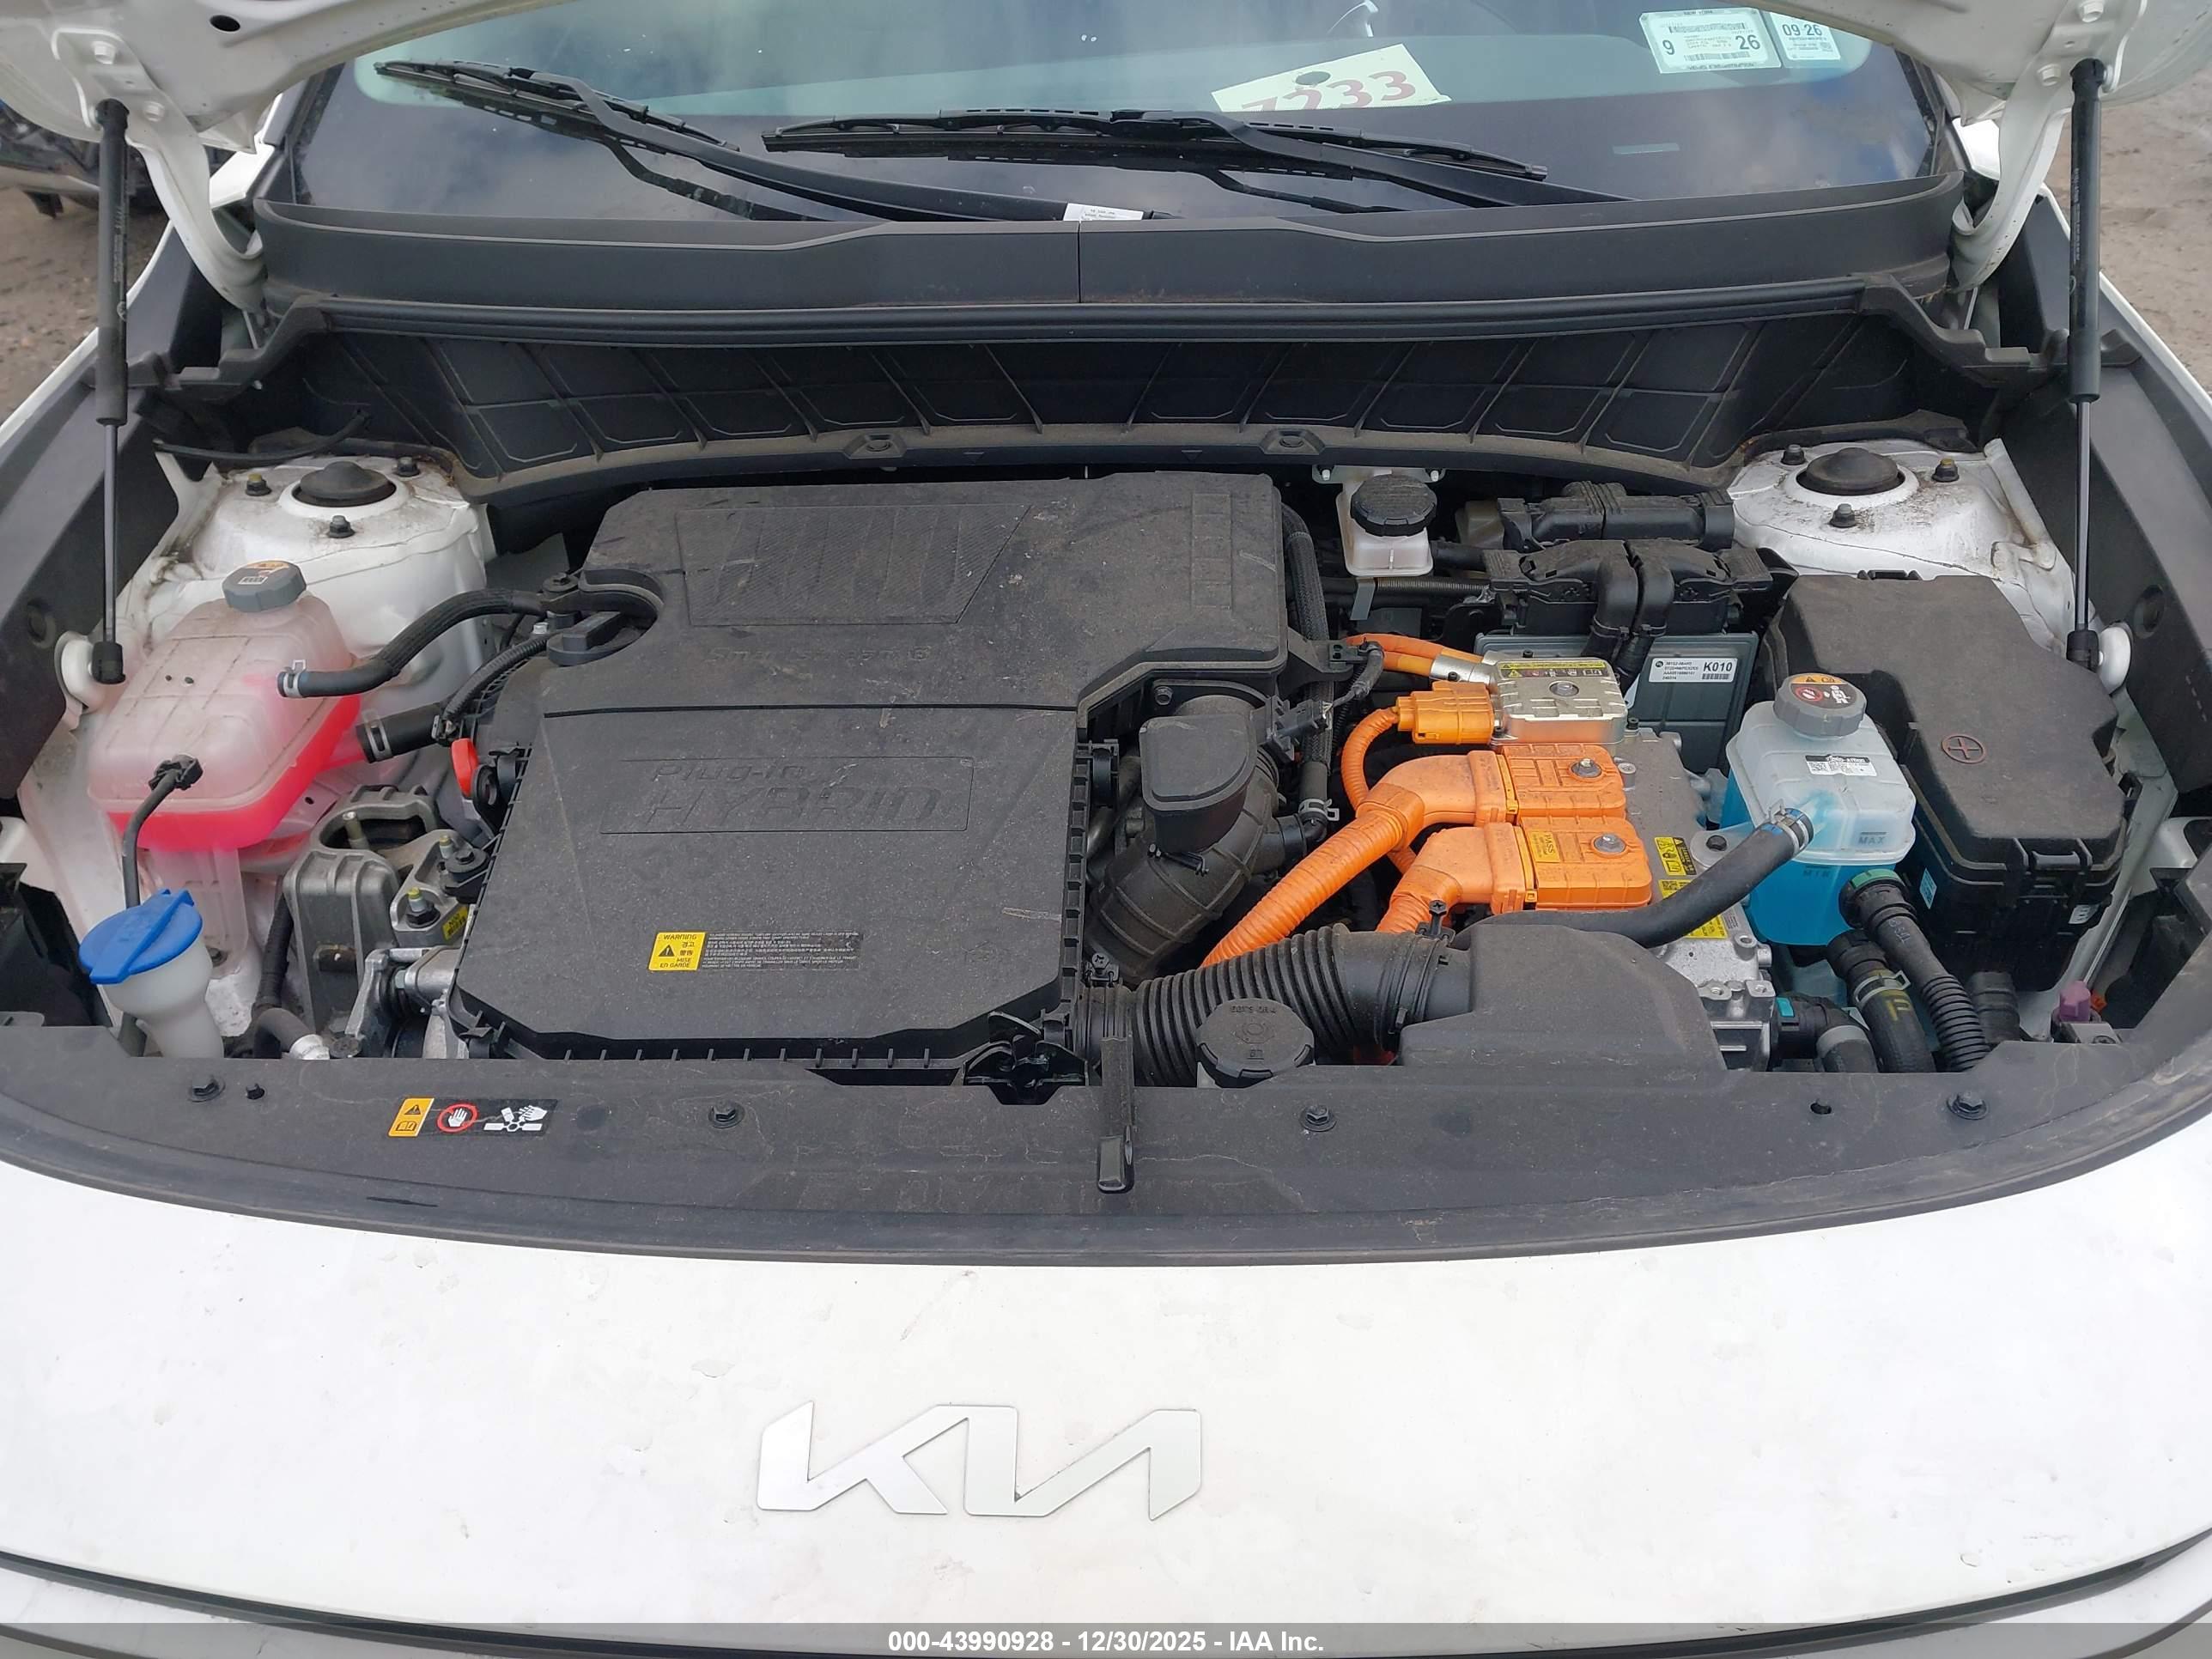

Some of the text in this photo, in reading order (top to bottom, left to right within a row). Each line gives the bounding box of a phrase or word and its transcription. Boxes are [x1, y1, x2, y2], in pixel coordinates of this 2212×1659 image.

[1662, 40, 1674, 55] 9
[1735, 34, 1760, 50] 26
[1703, 661, 1733, 673] K010
[1858, 836, 1886, 845] MAX
